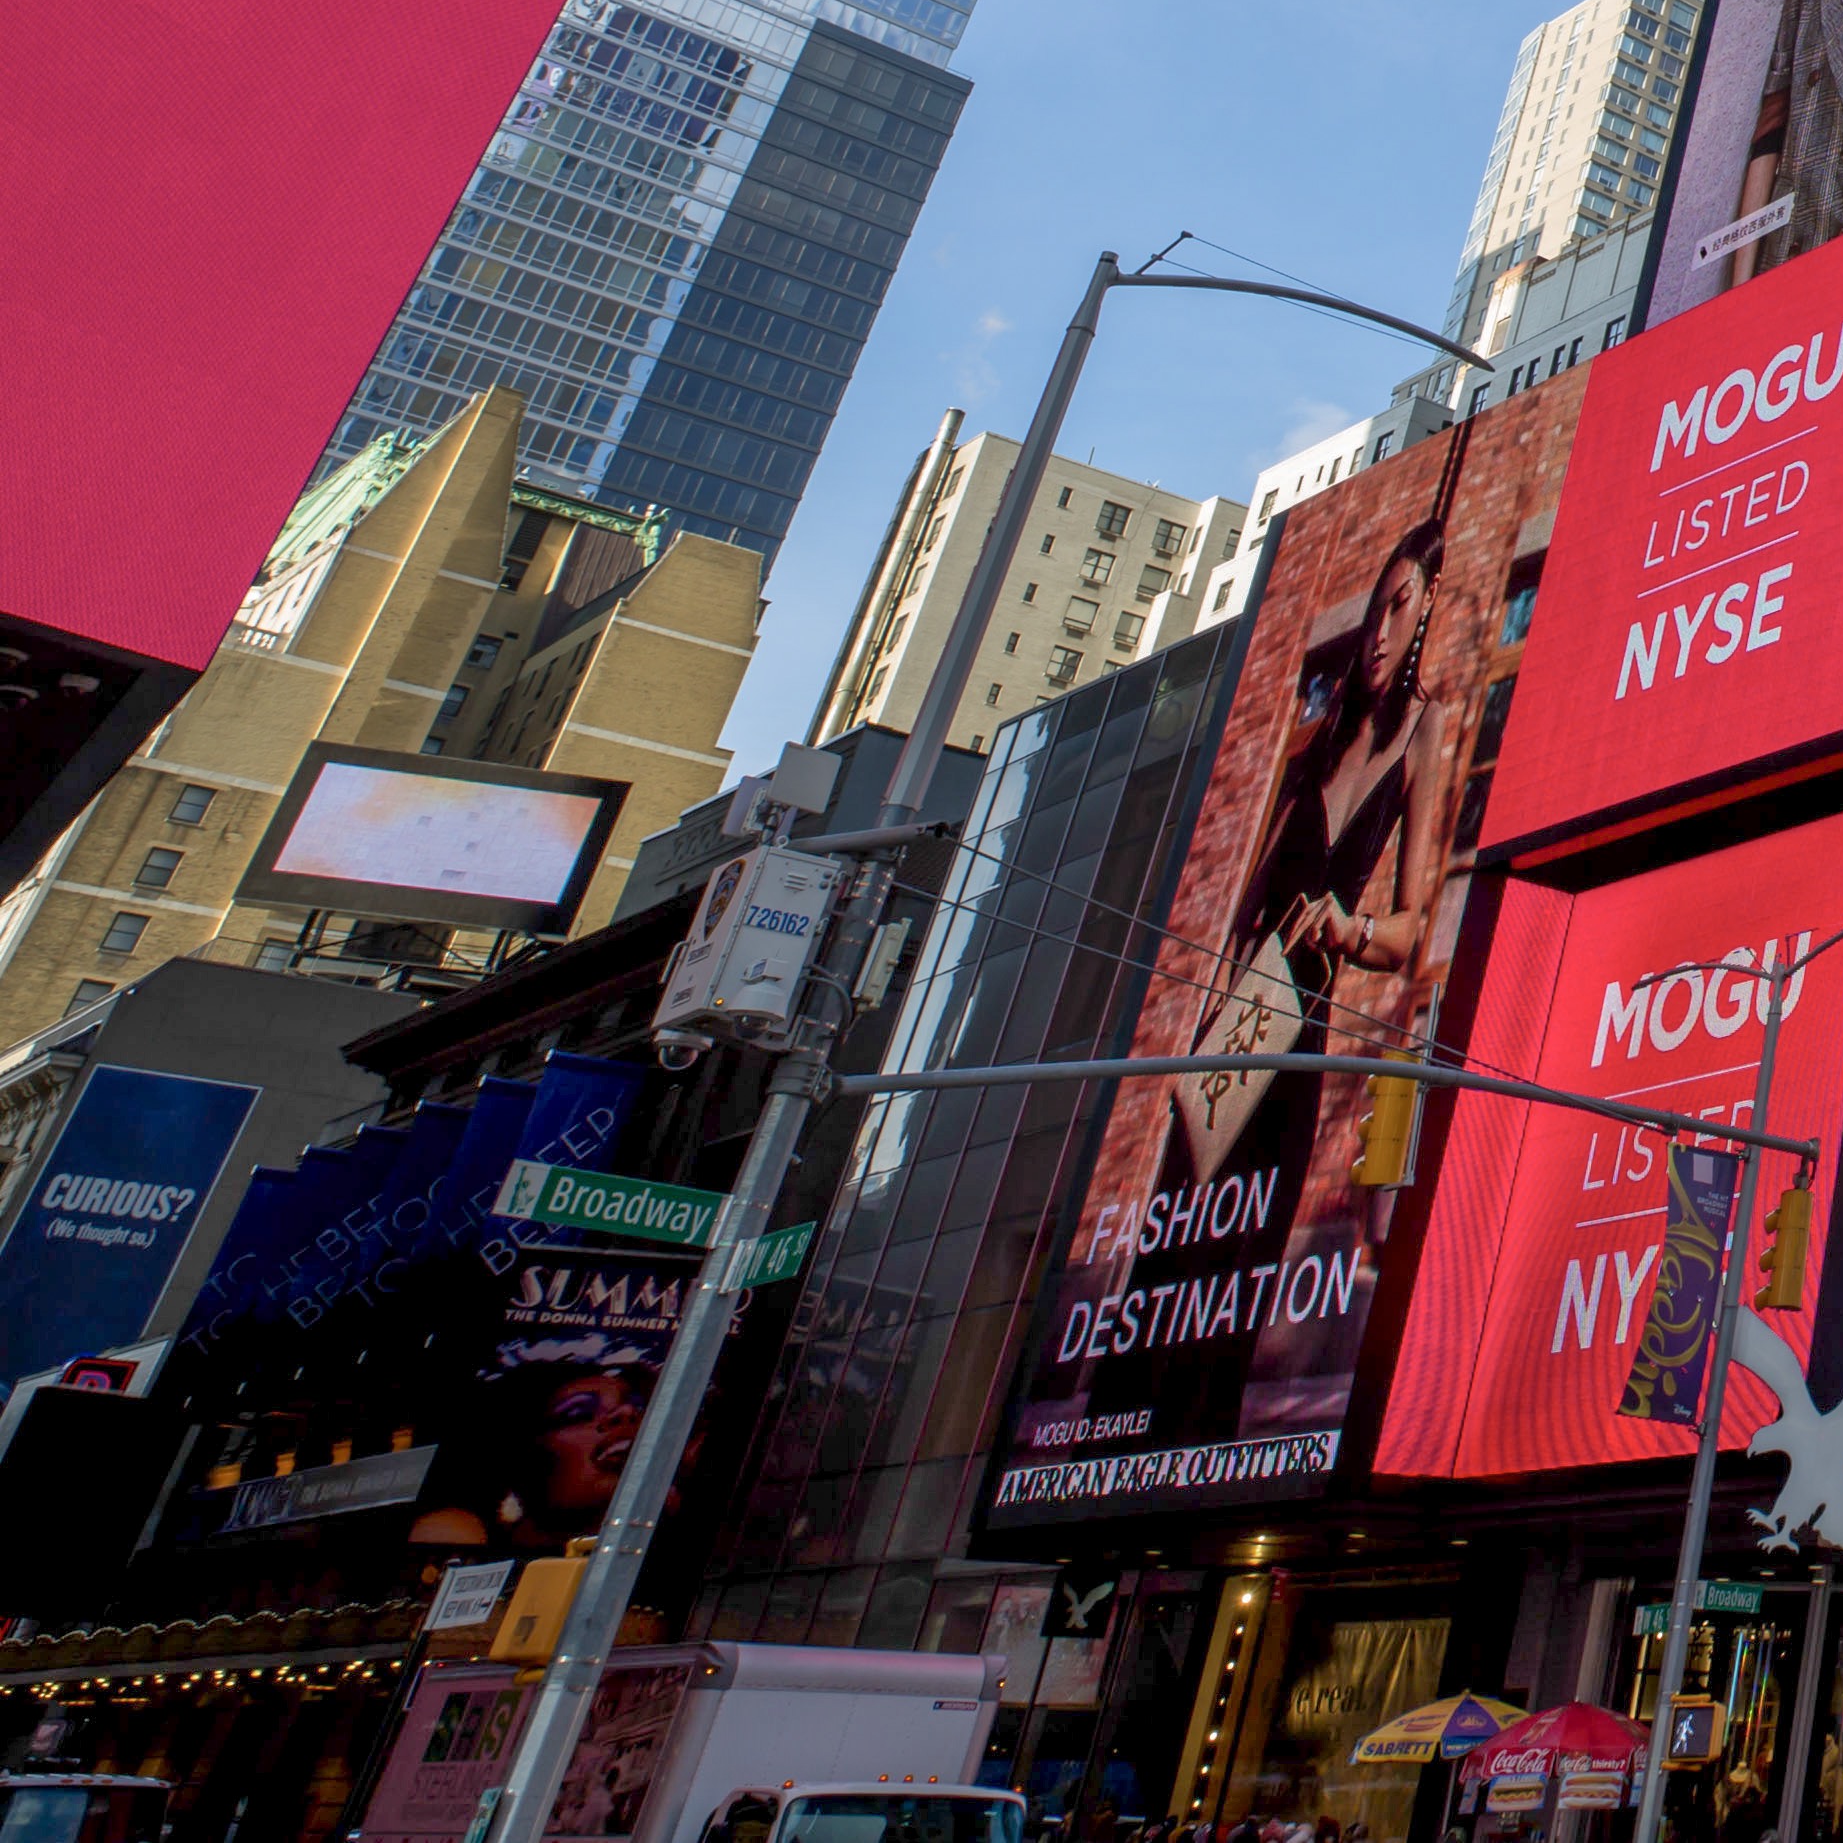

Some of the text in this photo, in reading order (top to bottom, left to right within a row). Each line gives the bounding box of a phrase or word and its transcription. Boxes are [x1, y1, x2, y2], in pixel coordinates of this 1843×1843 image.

[1643, 460, 1809, 567] LISTED
[1615, 562, 1793, 700] NYSE
[1591, 932, 1812, 1068] MOGU
[41, 1172, 196, 1222] CURIOUS?
[547, 1172, 713, 1245] Broadway
[1087, 1166, 1279, 1265] FASHION
[77, 1223, 126, 1247] thought
[540, 1310, 667, 1332] DONNA SUMMER
[1057, 1247, 1362, 1362] DESTINATION
[1000, 1433, 1331, 1504] AMERICAN EAGLE OUTFITTERS
[1033, 1421, 1074, 1448] MOGU
[1707, 1585, 1761, 1609] Broadway
[1364, 1740, 1433, 1758] SABRETT
